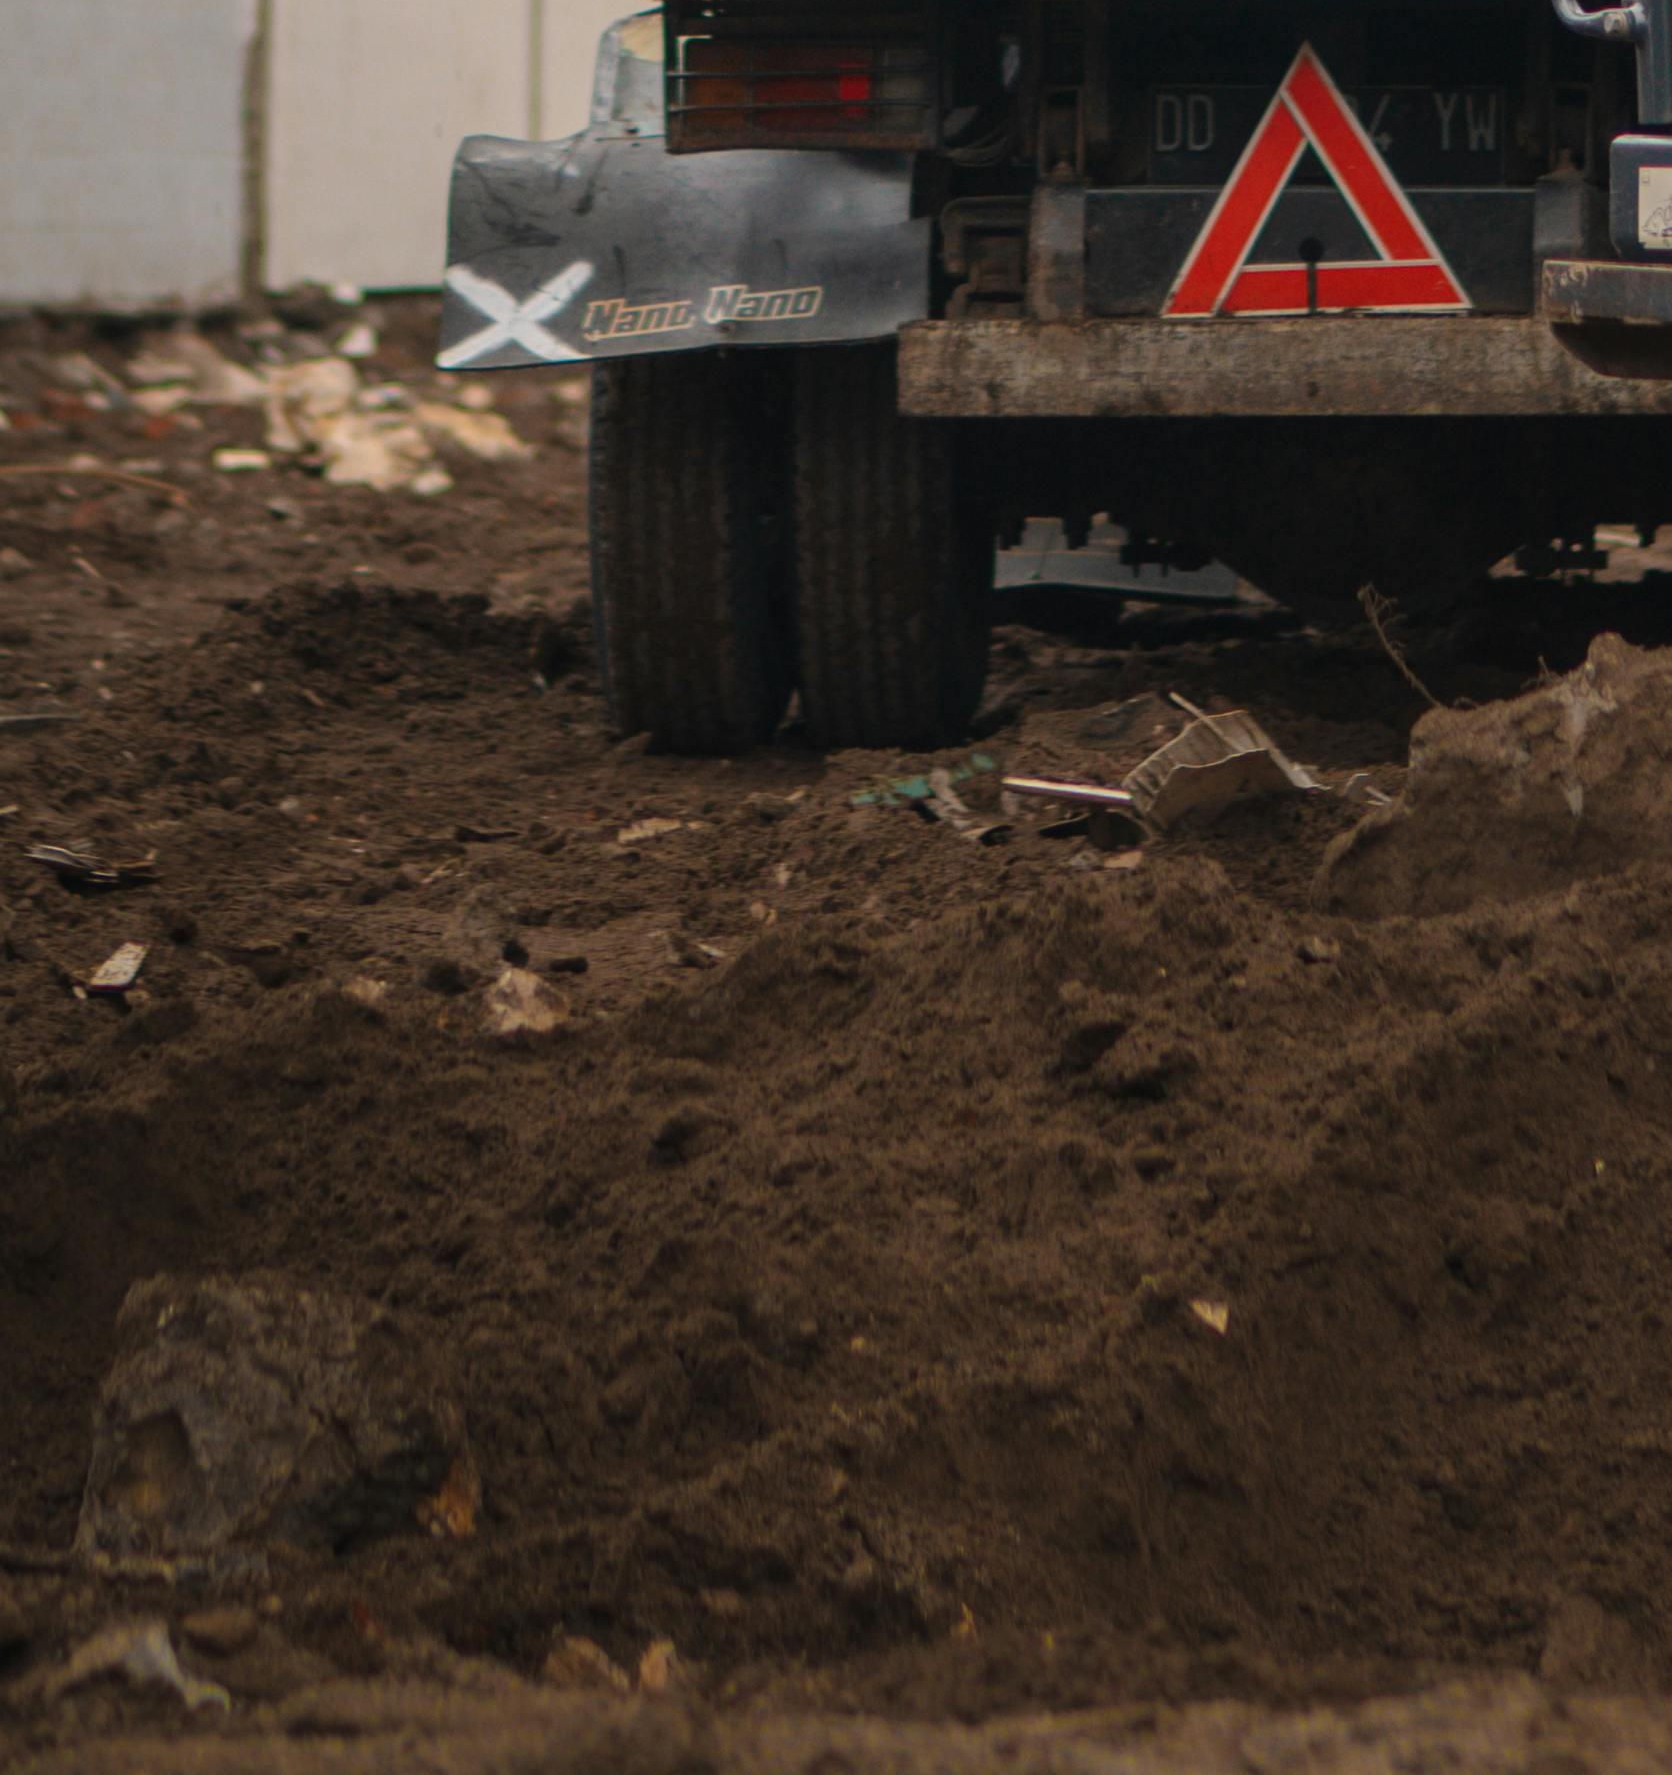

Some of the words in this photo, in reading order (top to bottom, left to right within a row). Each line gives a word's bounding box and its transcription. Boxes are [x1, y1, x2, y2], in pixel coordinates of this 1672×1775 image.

[1156, 94, 1214, 151] DD
[1434, 94, 1497, 151] YW
[705, 283, 824, 324] Nano
